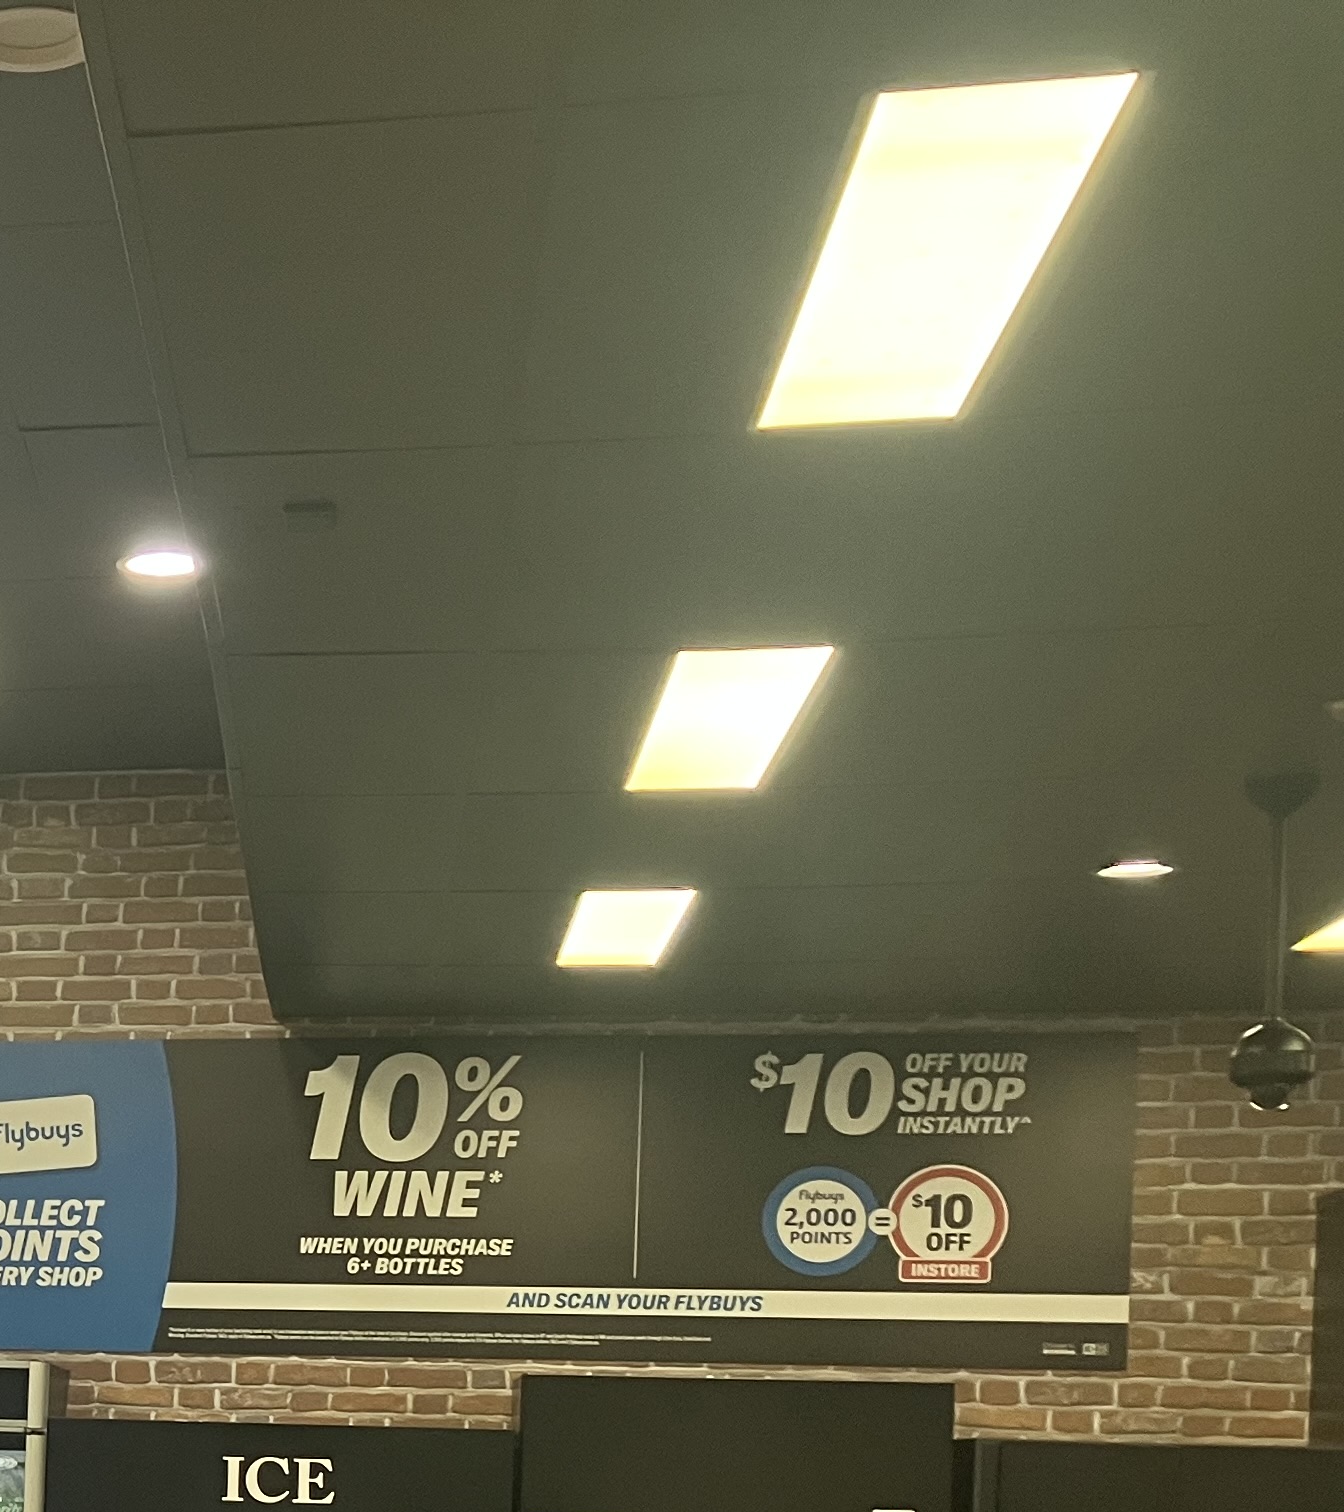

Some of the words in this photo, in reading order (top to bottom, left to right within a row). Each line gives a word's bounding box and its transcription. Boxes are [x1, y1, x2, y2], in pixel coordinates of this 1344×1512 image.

[905, 1053, 952, 1074] OFF
[960, 1052, 1028, 1073] YOUR
[750, 1051, 895, 1135] $10
[897, 1077, 1026, 1113] SHOP
[454, 1130, 520, 1158] OFF
[784, 1207, 856, 1229] 2,000
[912, 1193, 973, 1230] $10
[300, 1237, 358, 1254] WHEN
[362, 1238, 406, 1255] YOU
[407, 1239, 513, 1256] PURCHASE
[790, 1231, 853, 1246] POINTS
[926, 1232, 971, 1252] OFF
[36, 1266, 103, 1287] SHOP
[347, 1257, 372, 1274] 6+
[375, 1258, 464, 1276] BOTTLES
[911, 1263, 980, 1278] INSTORE
[507, 1292, 550, 1309] AND
[554, 1293, 611, 1310] SCAN
[616, 1294, 669, 1311] YOUR
[674, 1294, 763, 1312] FLYBUYS
[221, 1456, 335, 1504] ICE
